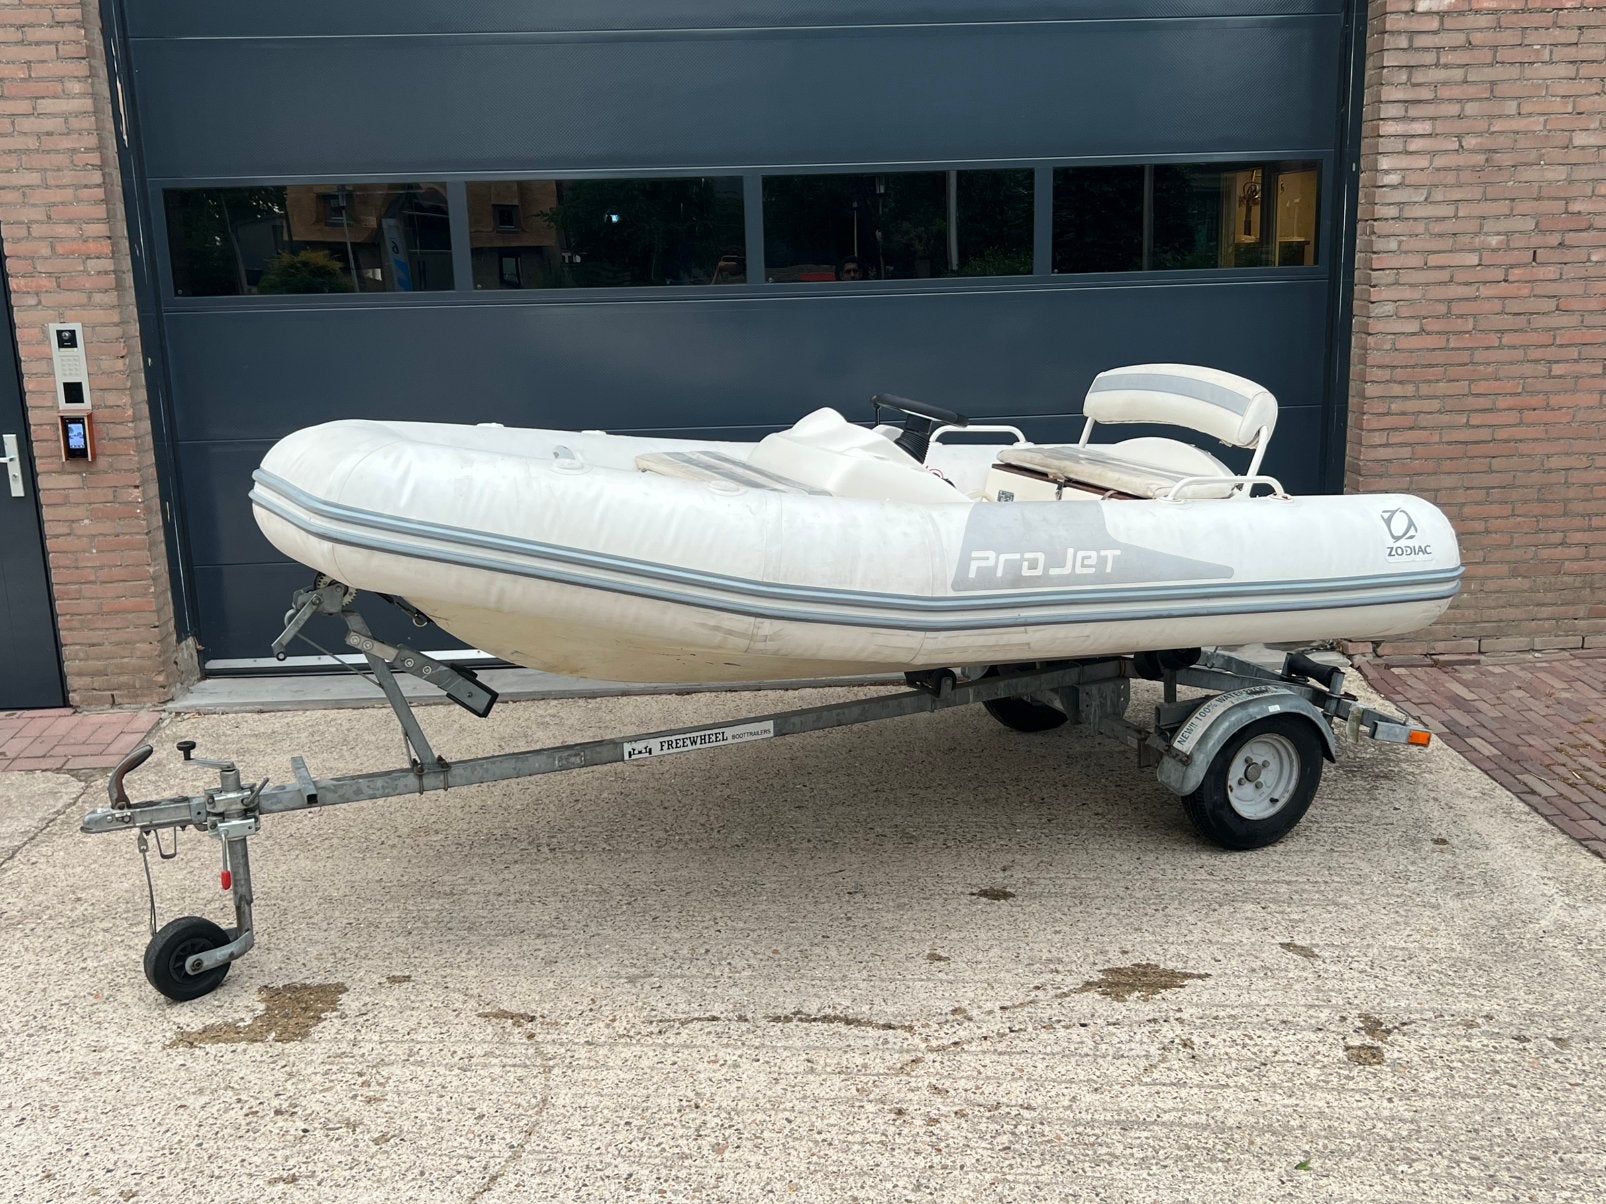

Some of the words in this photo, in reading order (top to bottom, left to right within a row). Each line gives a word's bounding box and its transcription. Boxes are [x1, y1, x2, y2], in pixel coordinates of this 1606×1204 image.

[1386, 544, 1432, 557] ZODIAC
[1195, 702, 1218, 722] 100%
[659, 731, 728, 751] FREEWHEEL
[731, 729, 771, 740] BOOTTRAILERS
